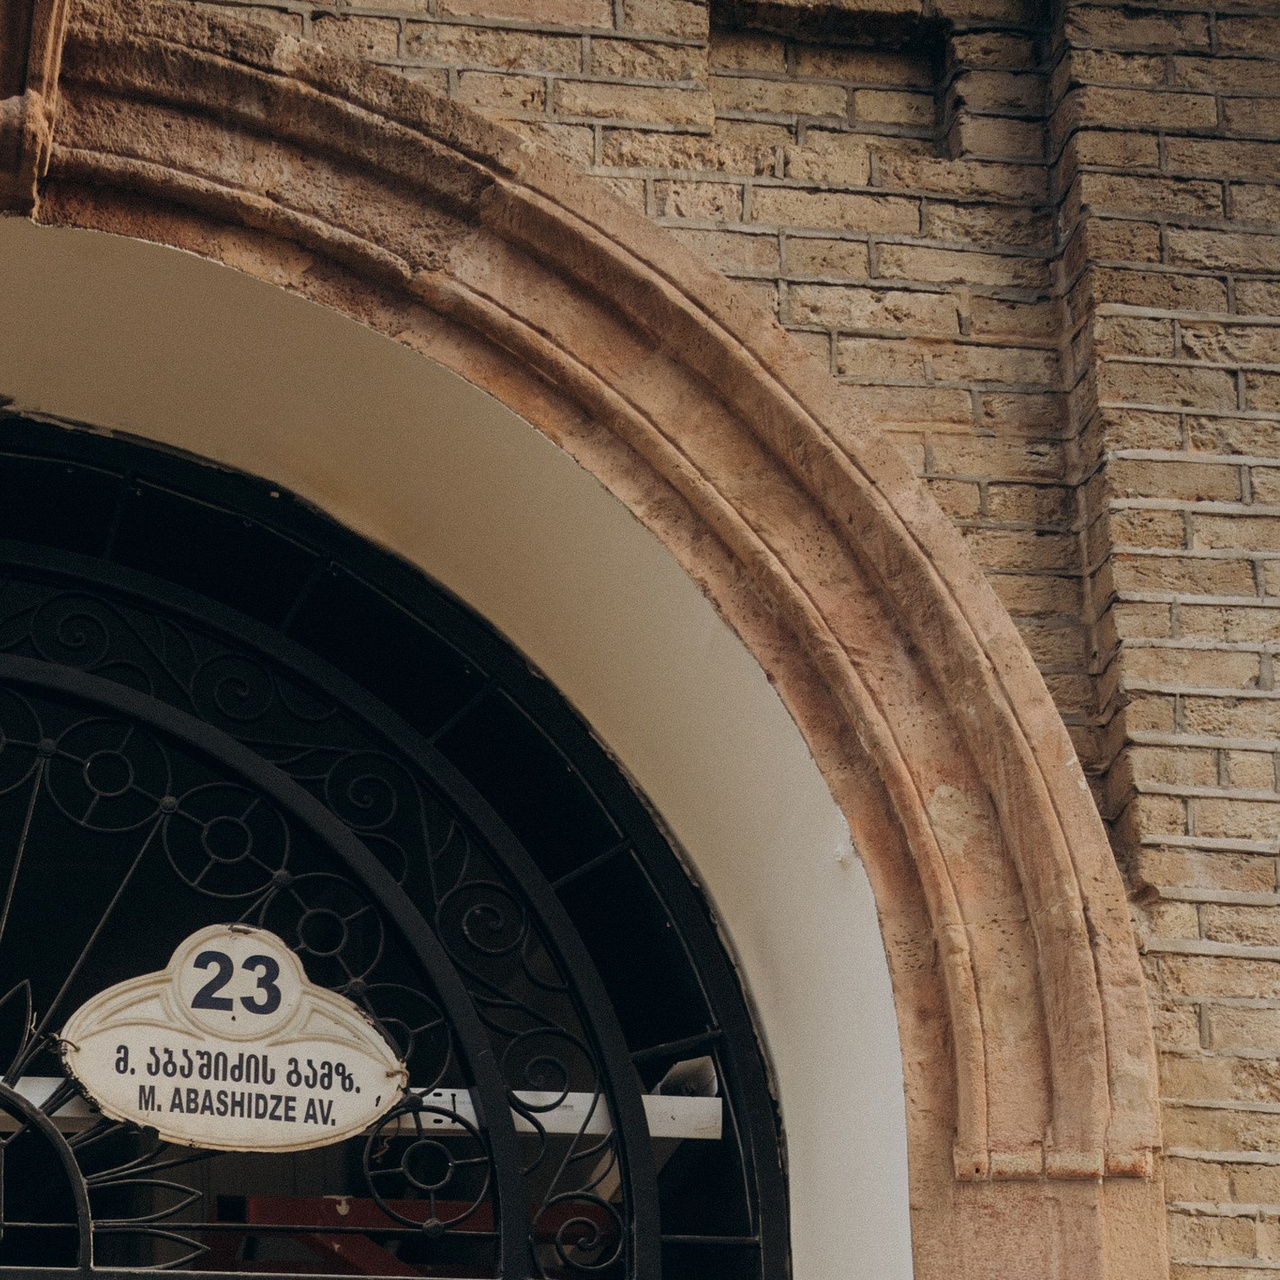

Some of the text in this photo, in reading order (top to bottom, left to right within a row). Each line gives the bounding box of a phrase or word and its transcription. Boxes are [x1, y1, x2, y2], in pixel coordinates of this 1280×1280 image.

[190, 950, 282, 1015] 23
[115, 1044, 361, 1094] მ. აბაშიძის გამზ.
[138, 1084, 336, 1127] M. ABASHIDZE AV.
